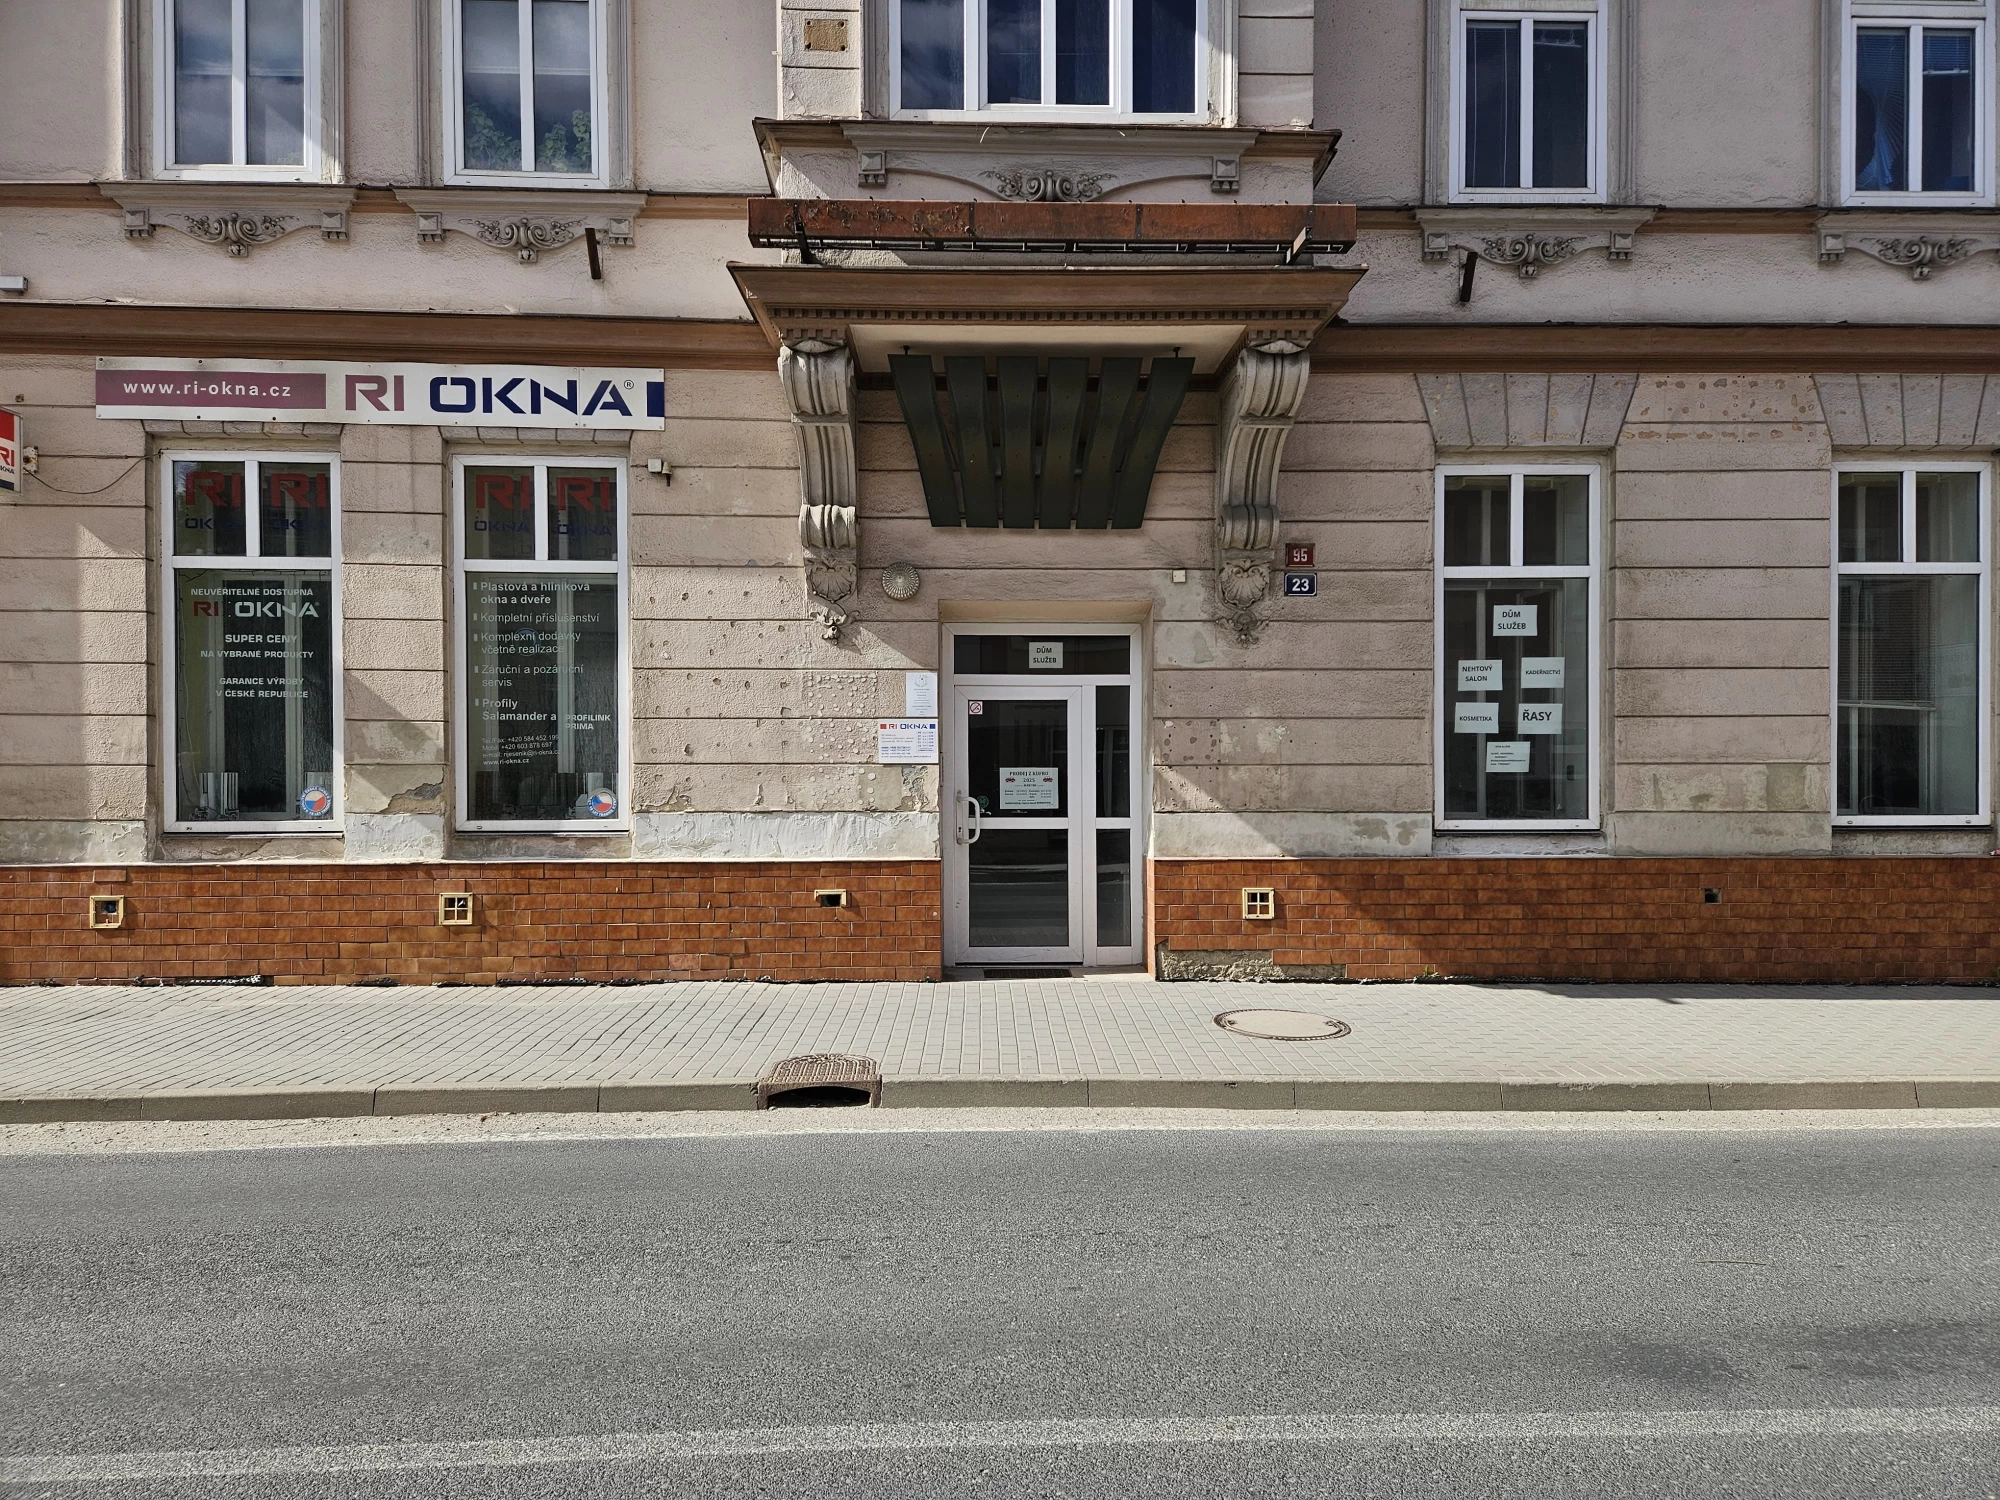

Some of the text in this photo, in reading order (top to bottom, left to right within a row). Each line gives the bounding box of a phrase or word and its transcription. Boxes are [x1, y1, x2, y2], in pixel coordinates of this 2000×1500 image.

[124, 381, 291, 397] www.ri-okna.cz
[345, 374, 405, 411] RI
[0, 463, 15, 475] KNA
[185, 471, 242, 507] RI
[271, 473, 327, 508] RI
[476, 475, 531, 510] RI
[556, 477, 611, 511] RI
[185, 518, 242, 530] OK
[1293, 548, 1308, 562] 95
[481, 582, 528, 591] Plastová
[540, 582, 590, 591] hliníková
[1292, 578, 1309, 591] 23
[481, 595, 508, 604] okna
[520, 595, 551, 604] dveře
[194, 601, 219, 616] RI
[1502, 609, 1521, 618] DŮM
[481, 613, 600, 623] Kompletní příslušenství
[1497, 621, 1527, 630] SLUŽEB
[225, 634, 298, 644] SUPER CENY
[481, 631, 581, 642] Komplexní dodávky
[200, 650, 314, 659] NA VYBRANÉ PRODUKTY
[481, 644, 564, 654] včetně realizace
[482, 664, 521, 674] Záruční
[1462, 664, 1493, 672] NEHTOVÝ
[267, 677, 304, 685] VÝROBY
[482, 678, 512, 687] servis
[225, 689, 255, 698] ČESKÉ
[258, 690, 309, 698] REPUBLICE
[482, 698, 518, 710] Profily
[482, 710, 557, 721] Salamander a
[565, 714, 611, 722] PROFILINK
[1522, 709, 1552, 721] ŘASY
